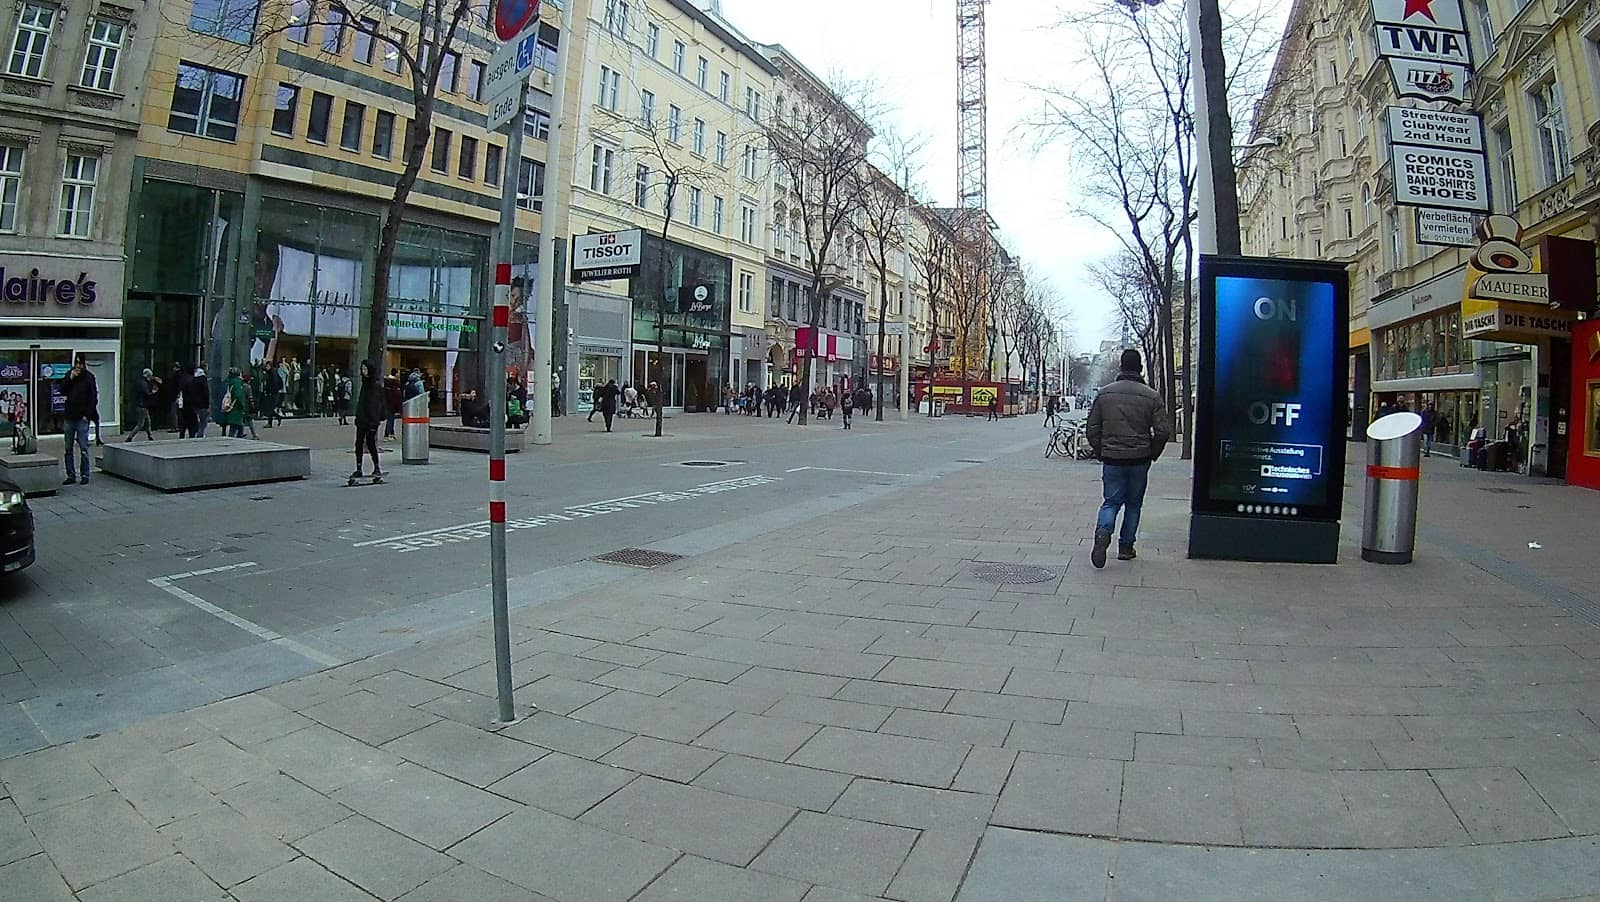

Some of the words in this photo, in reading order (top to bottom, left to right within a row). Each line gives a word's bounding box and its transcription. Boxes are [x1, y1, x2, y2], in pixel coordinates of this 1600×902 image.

[1383, 27, 1463, 56] TWA
[493, 96, 513, 121] Ende
[1401, 109, 1468, 124] Streetwear
[1403, 120, 1470, 134] Clubwear
[1404, 130, 1430, 141] 2nd
[1435, 133, 1471, 145] Hand
[1405, 154, 1473, 169] COMICS
[1406, 164, 1475, 180] RECORDS
[1409, 186, 1477, 201] SHOES
[1423, 224, 1469, 235] vermieten
[583, 244, 633, 259] TISSOT
[581, 269, 612, 278] JUWELIER
[612, 266, 632, 275] ROTH
[0, 267, 97, 304] laire's
[1480, 278, 1549, 299] MAUERER
[1254, 297, 1297, 321] ON
[1464, 319, 1475, 332] DIE
[1474, 314, 1496, 329] TASCHE
[1504, 313, 1526, 327] DIE
[1529, 316, 1572, 333] TASCHE
[1248, 402, 1302, 426] OFF
